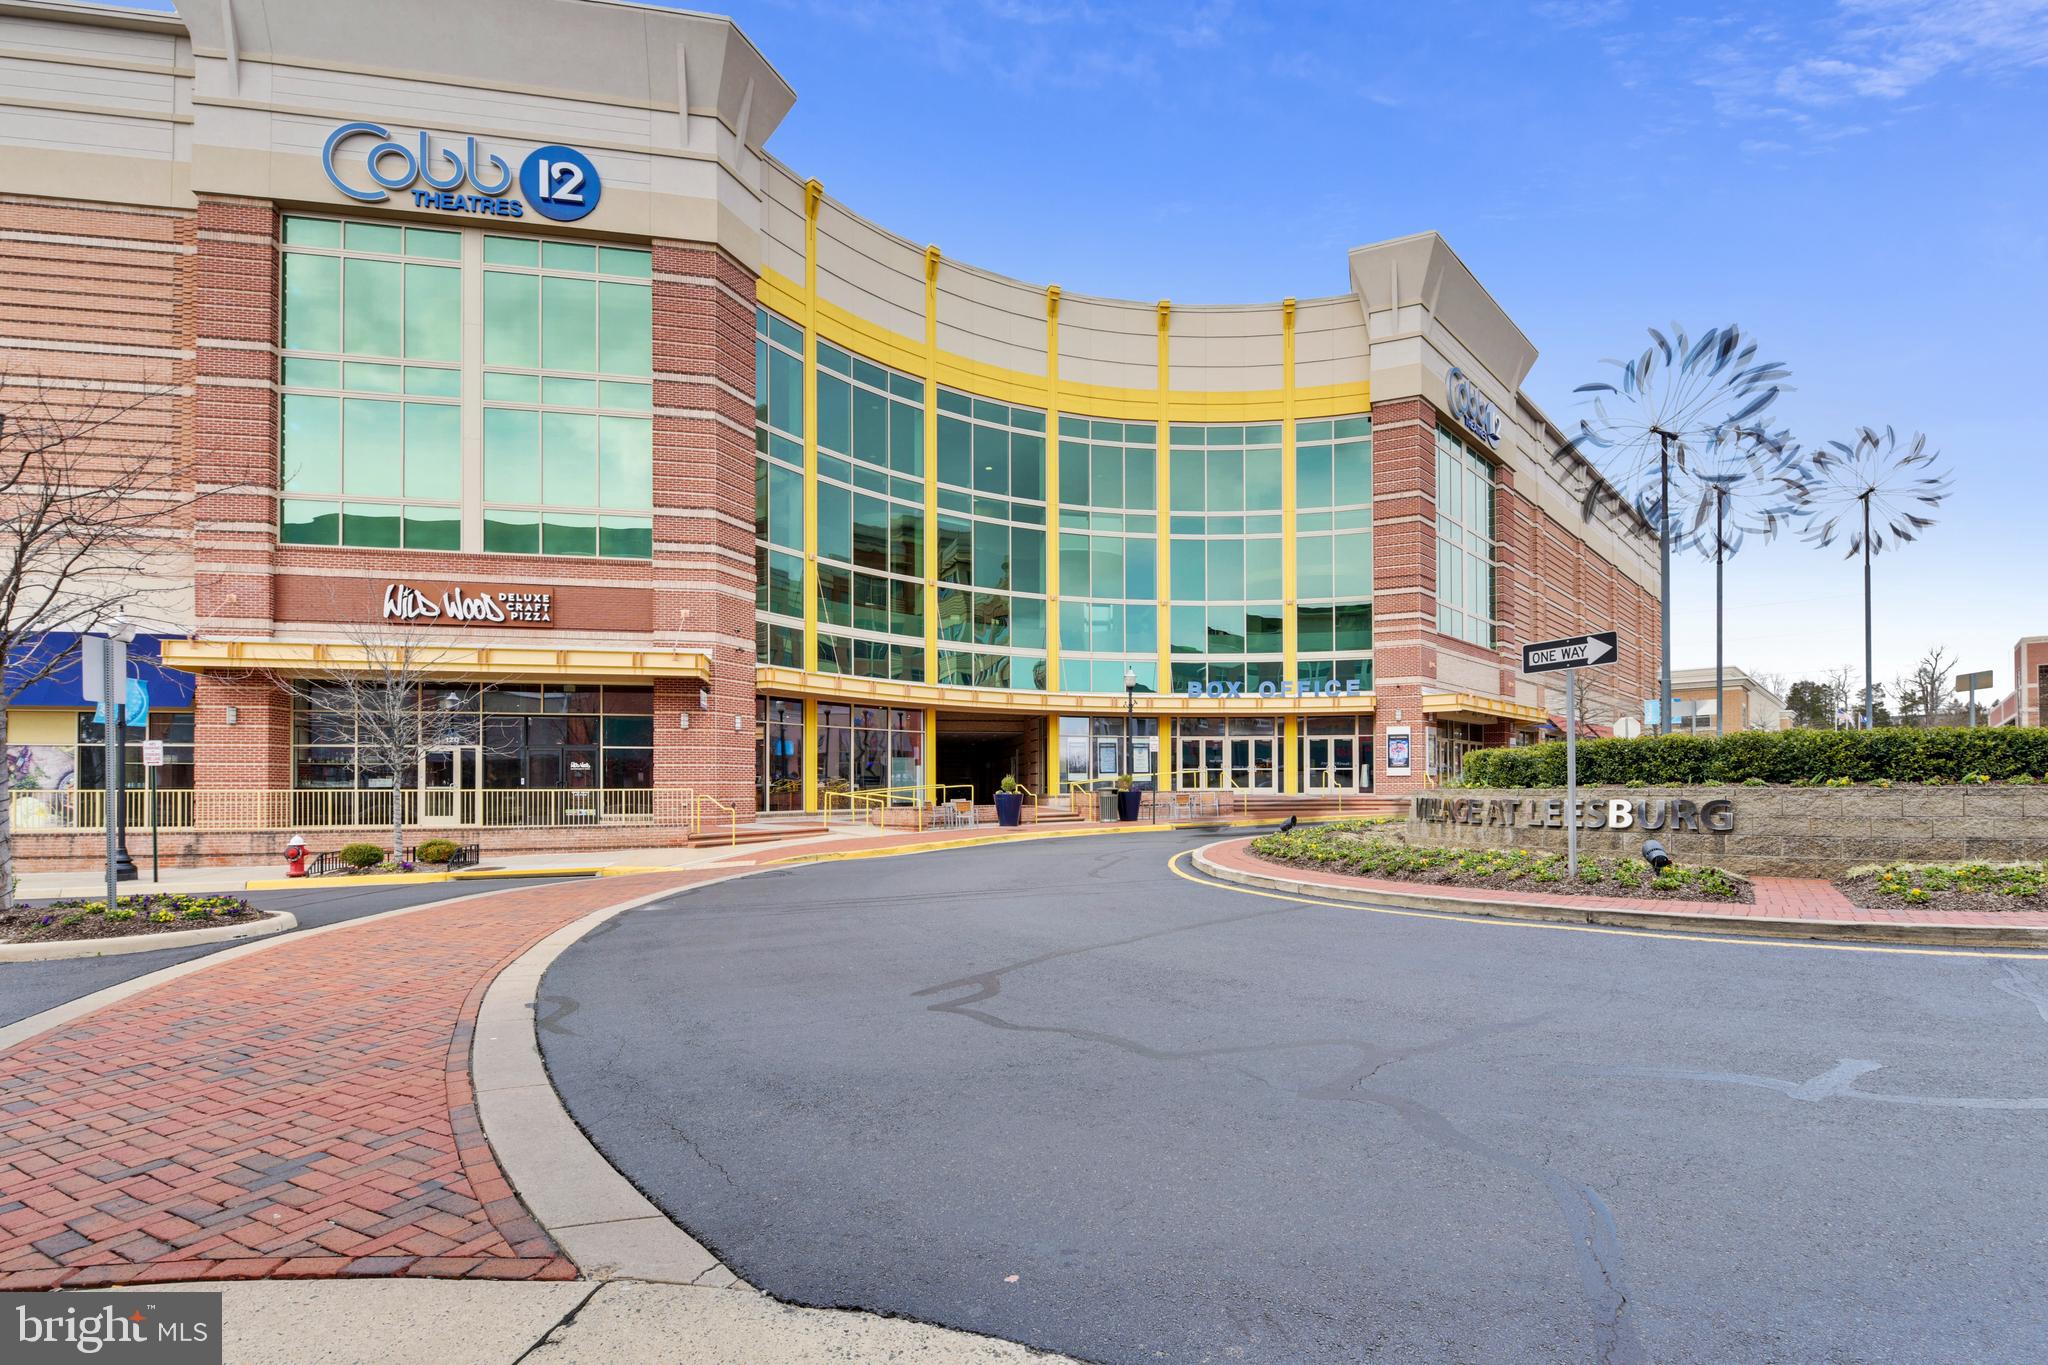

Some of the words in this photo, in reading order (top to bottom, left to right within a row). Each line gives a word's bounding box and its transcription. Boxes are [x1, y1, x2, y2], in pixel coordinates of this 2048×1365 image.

[322, 121, 513, 202] Cobb
[538, 159, 586, 204] 12
[411, 189, 524, 217] THEATRES
[498, 592, 551, 604] DELUXE
[505, 602, 551, 613] CRAFT
[510, 612, 551, 622] PIZZA
[1532, 649, 1557, 664] ONE
[1561, 645, 1588, 660] WAY
[1187, 680, 1242, 699] BOX
[1258, 679, 1362, 698] OFFICE
[1488, 799, 1521, 826] AT
[1526, 799, 1736, 831] LEESBURG
